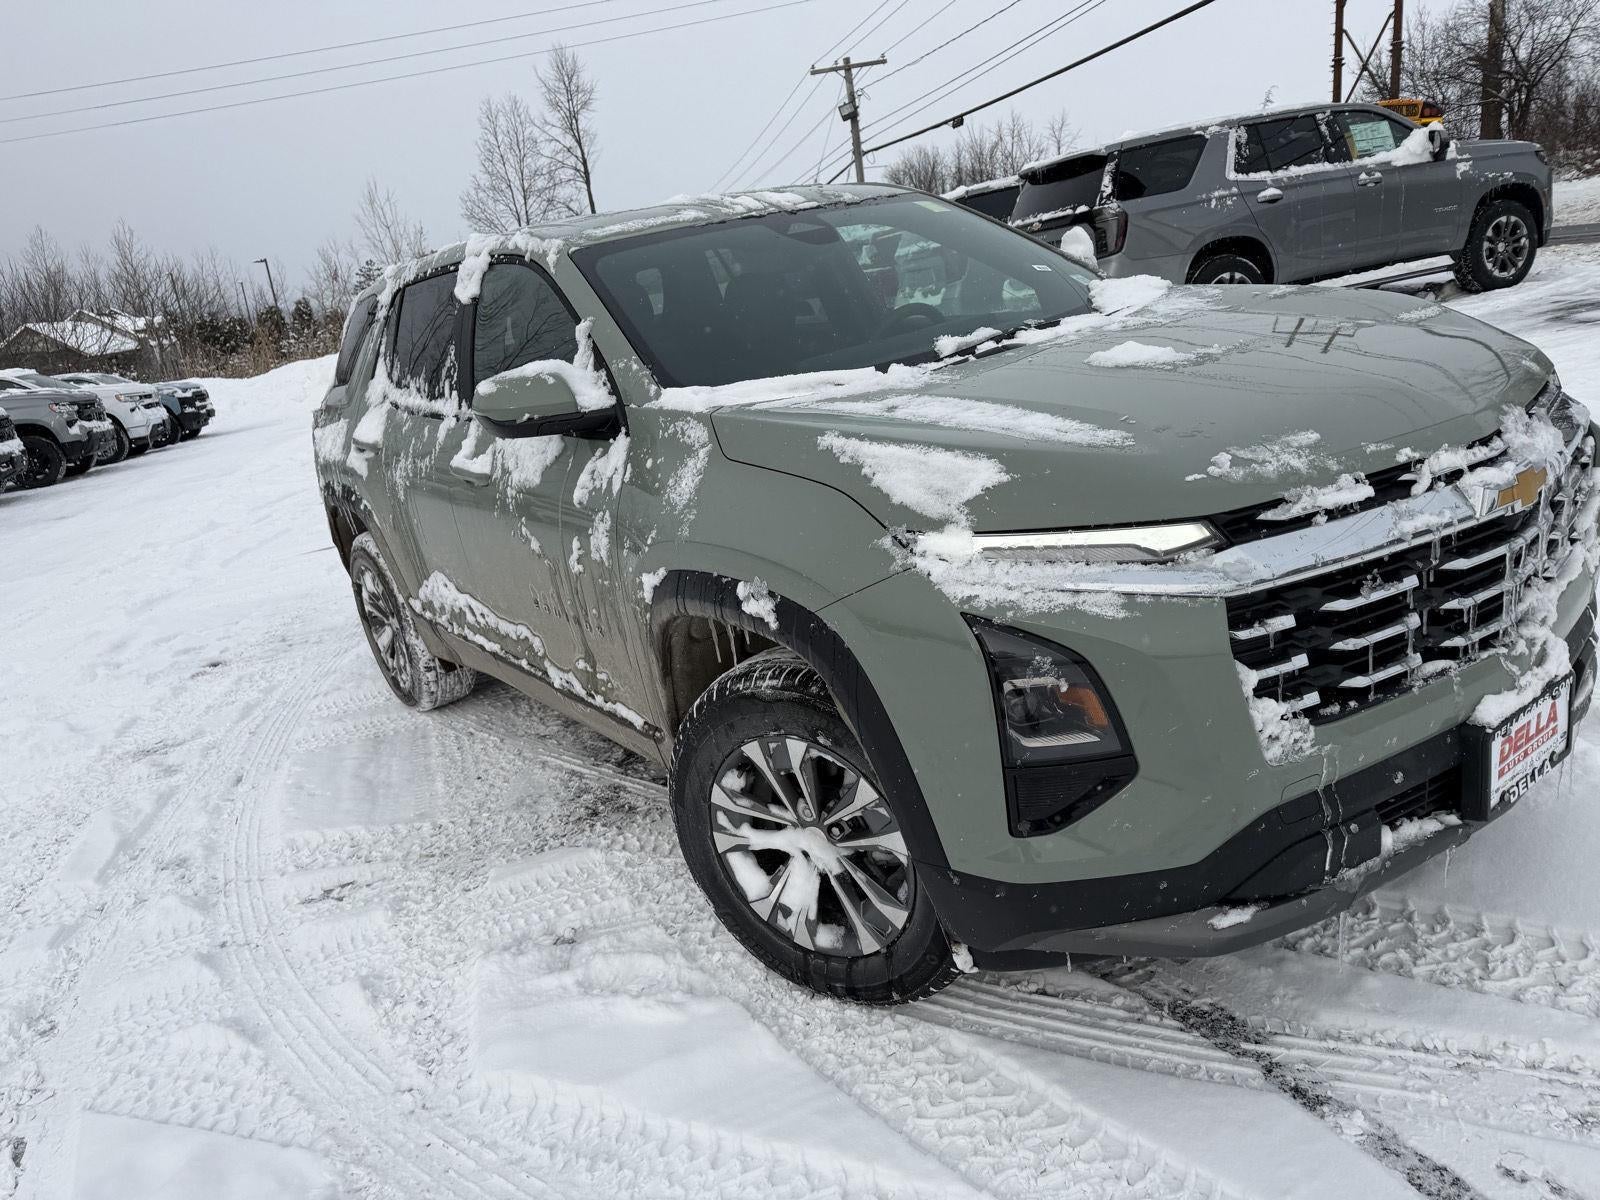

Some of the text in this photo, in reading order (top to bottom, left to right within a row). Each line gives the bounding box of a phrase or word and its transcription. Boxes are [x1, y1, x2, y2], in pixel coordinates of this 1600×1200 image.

[1498, 700, 1558, 766] DELLA
[1504, 730, 1553, 772] AUTO GROUP
[1509, 759, 1551, 803] DELLA
